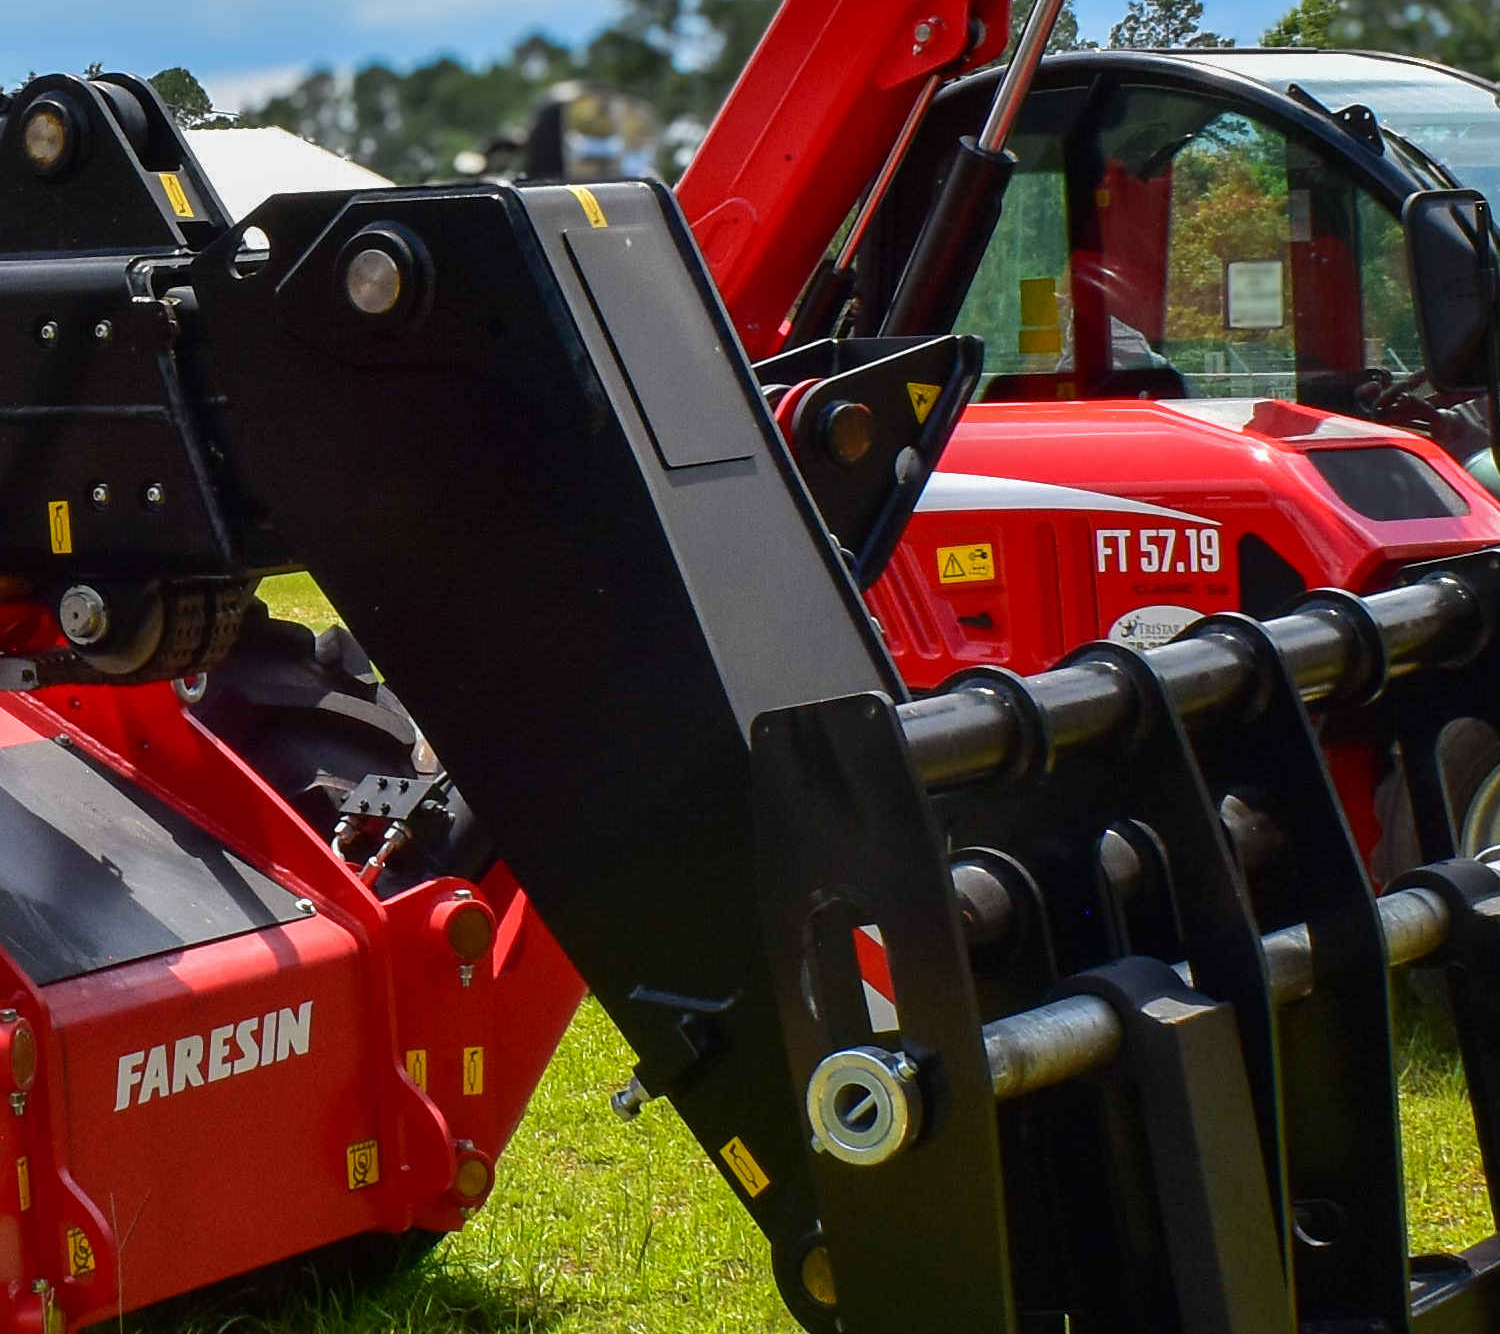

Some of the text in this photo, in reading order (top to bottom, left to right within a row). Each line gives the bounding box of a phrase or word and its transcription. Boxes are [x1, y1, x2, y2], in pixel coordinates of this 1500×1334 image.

[1096, 528, 1220, 573] FT 57.19
[113, 1000, 313, 1112] FARESIN
